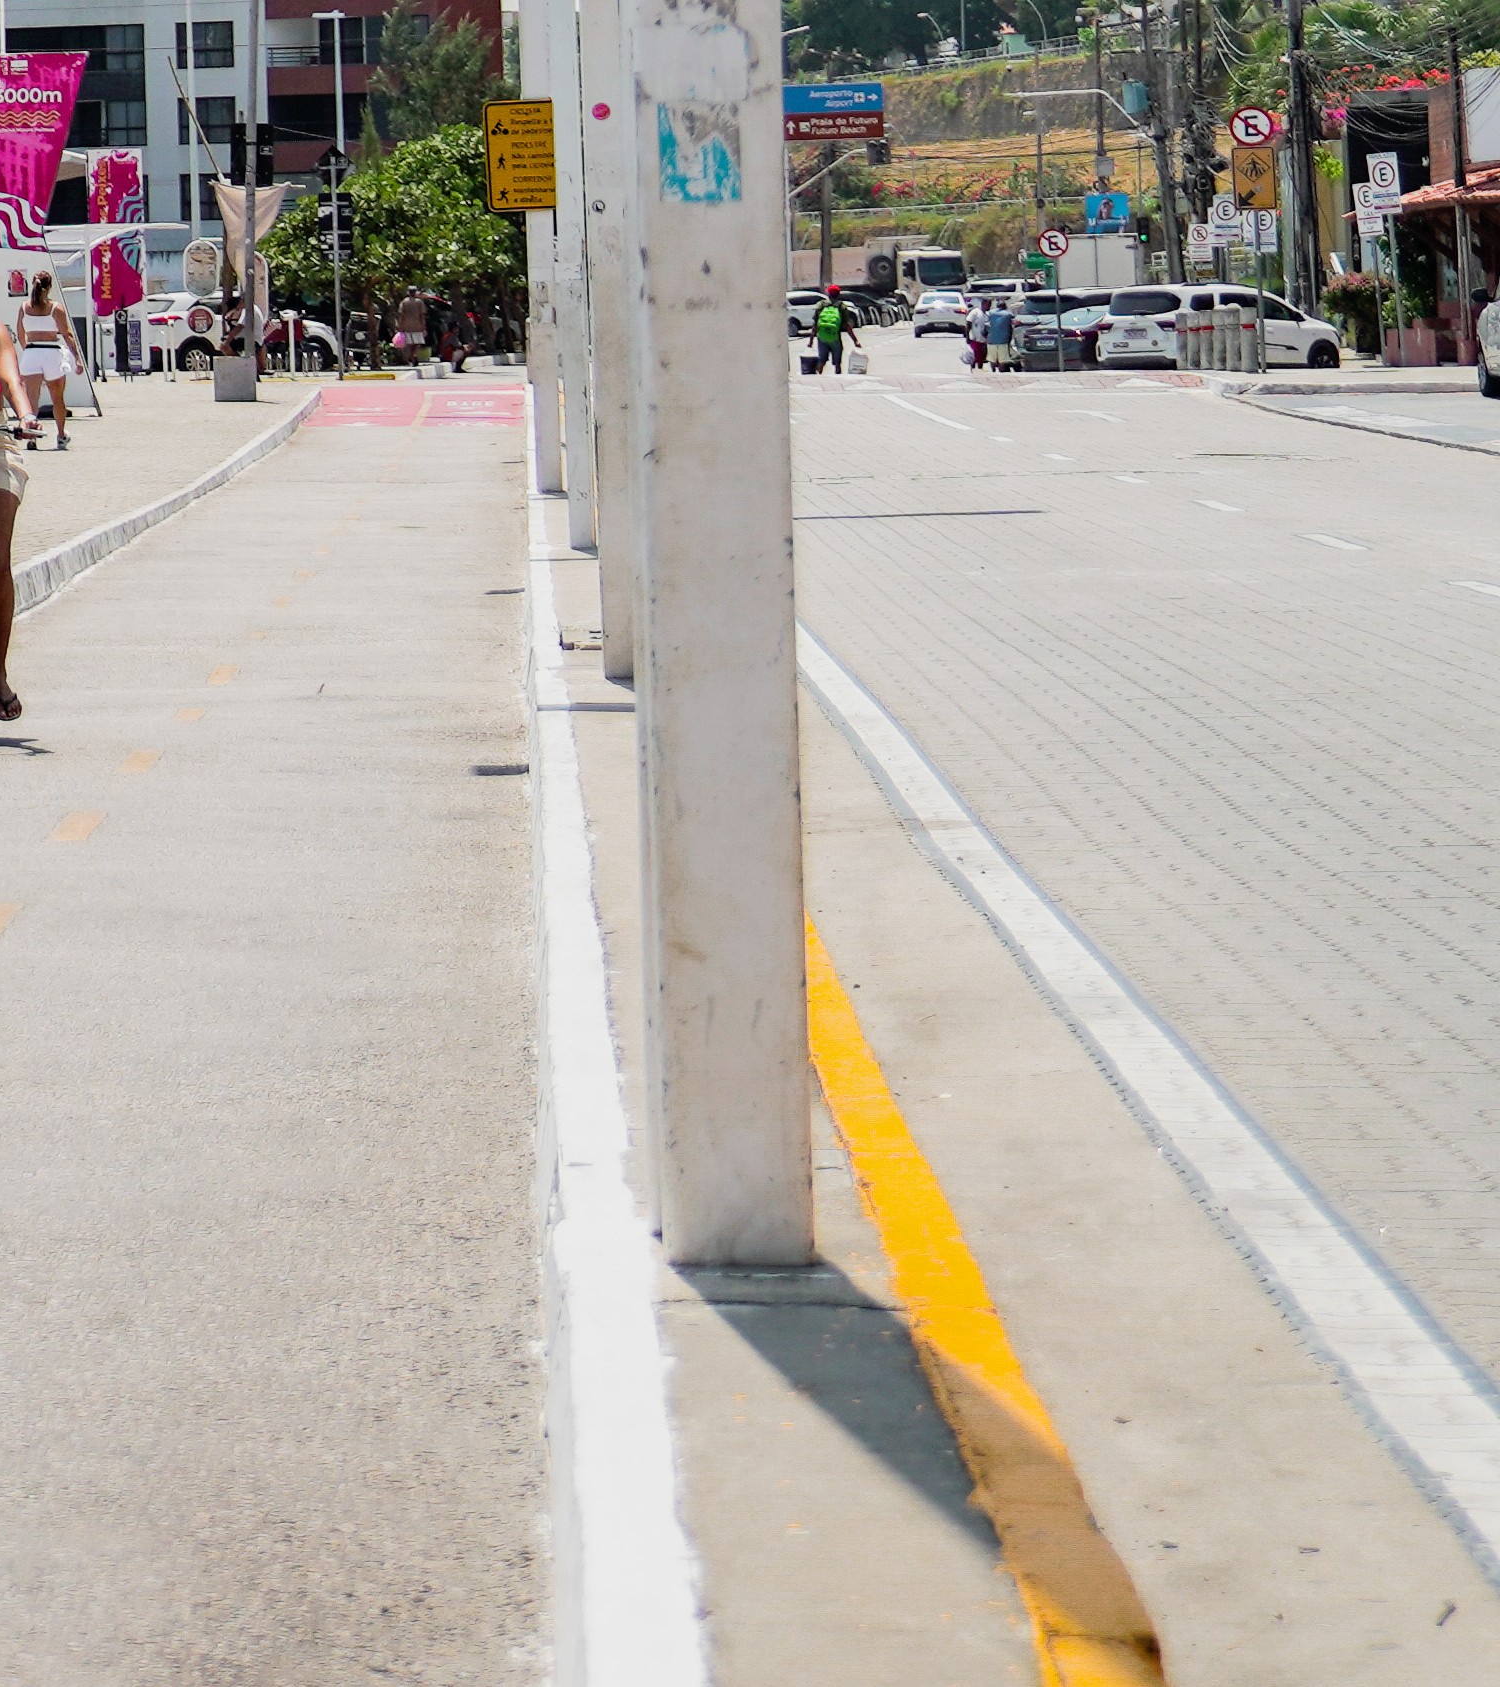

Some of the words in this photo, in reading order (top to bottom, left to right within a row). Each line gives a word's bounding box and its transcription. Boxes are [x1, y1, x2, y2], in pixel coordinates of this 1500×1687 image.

[809, 90, 854, 98] Aeroporto
[824, 99, 853, 108] Airport
[810, 117, 833, 126] Praia
[848, 116, 878, 125] Futuro
[1243, 115, 1260, 137] E
[1379, 167, 1388, 182] E
[1363, 190, 1370, 203] E
[1222, 204, 1230, 216] E
[1048, 234, 1058, 251] E
